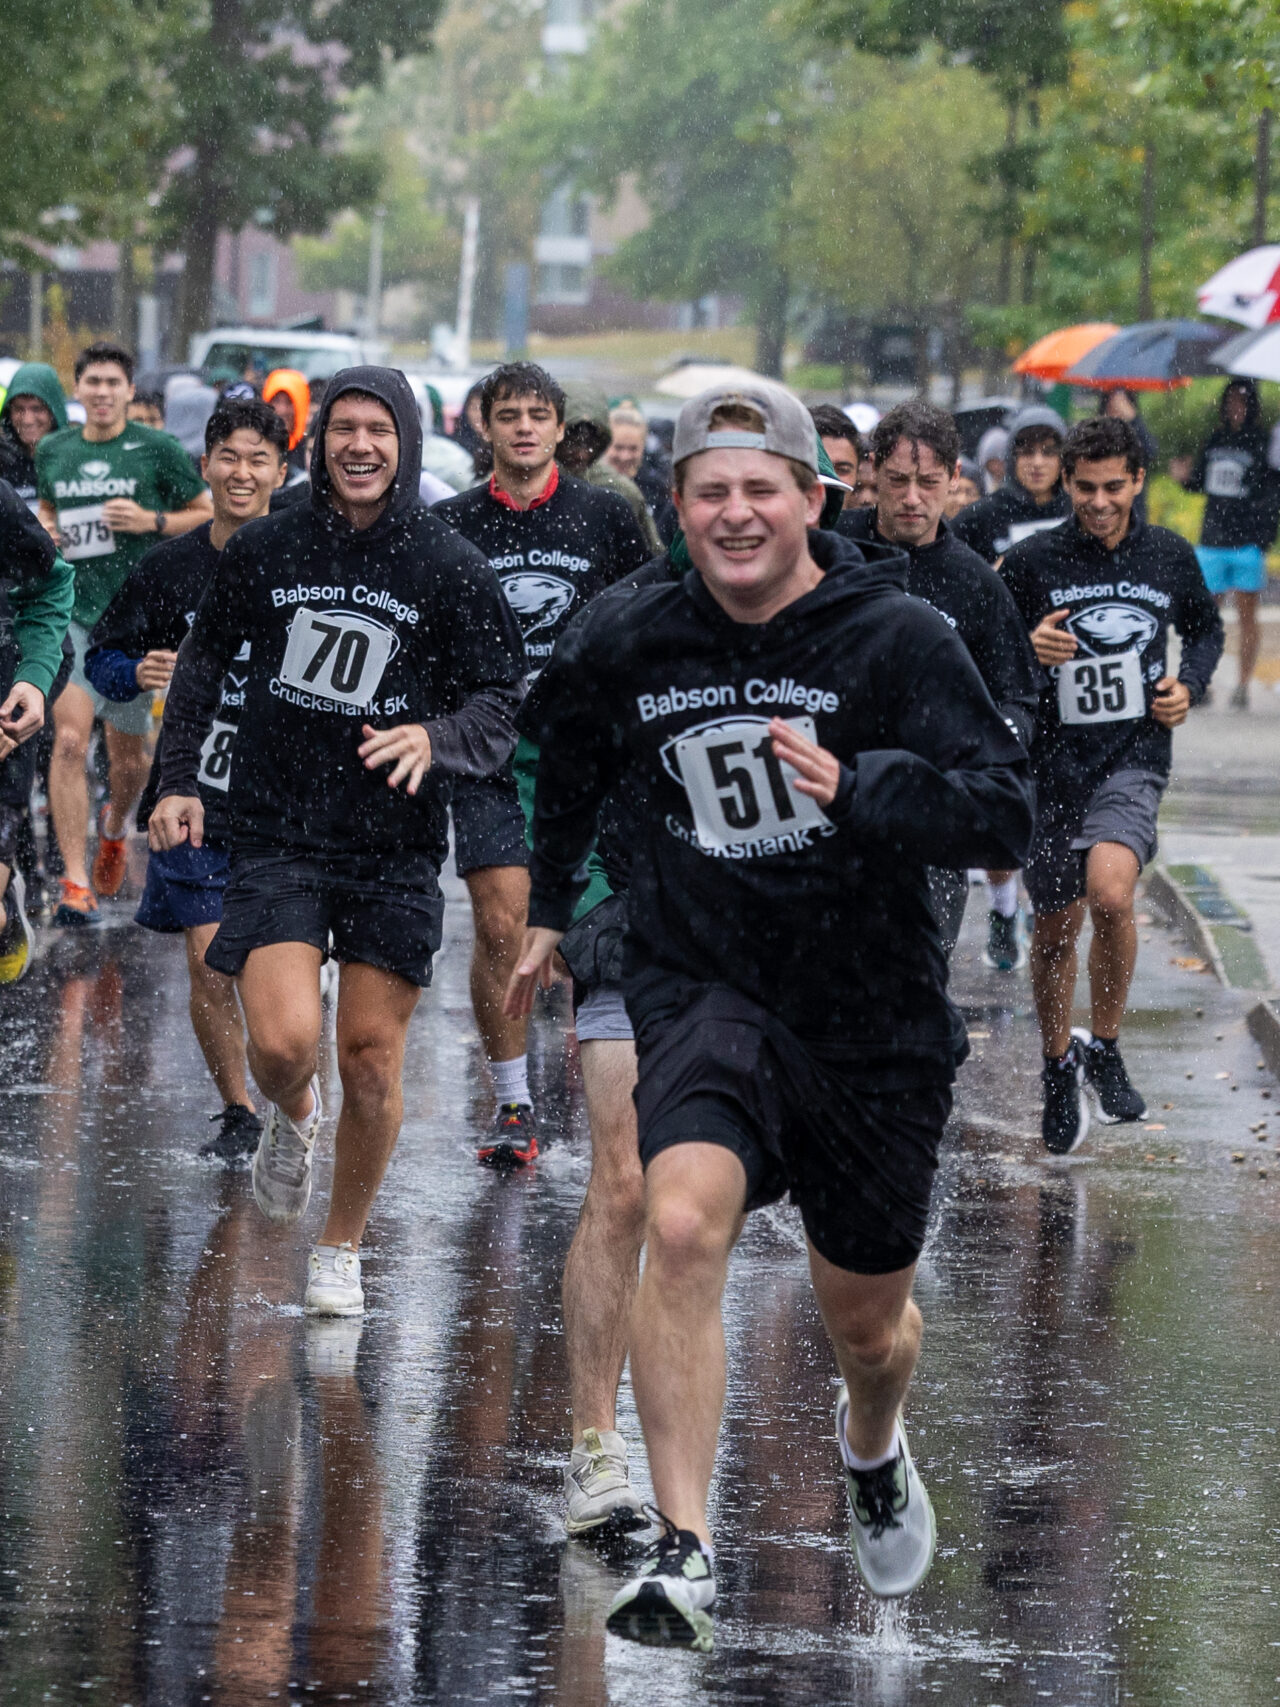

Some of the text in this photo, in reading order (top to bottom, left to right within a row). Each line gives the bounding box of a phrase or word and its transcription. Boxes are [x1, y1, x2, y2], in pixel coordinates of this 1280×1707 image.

[54, 478, 136, 498] BABSON
[527, 549, 591, 572] College
[271, 584, 420, 624] Babson College
[1050, 583, 1114, 607] Babson
[301, 619, 370, 694] 70
[384, 694, 409, 715] 5K
[636, 677, 840, 723] Babson College
[1074, 662, 1127, 716] 35
[705, 735, 797, 831] 51
